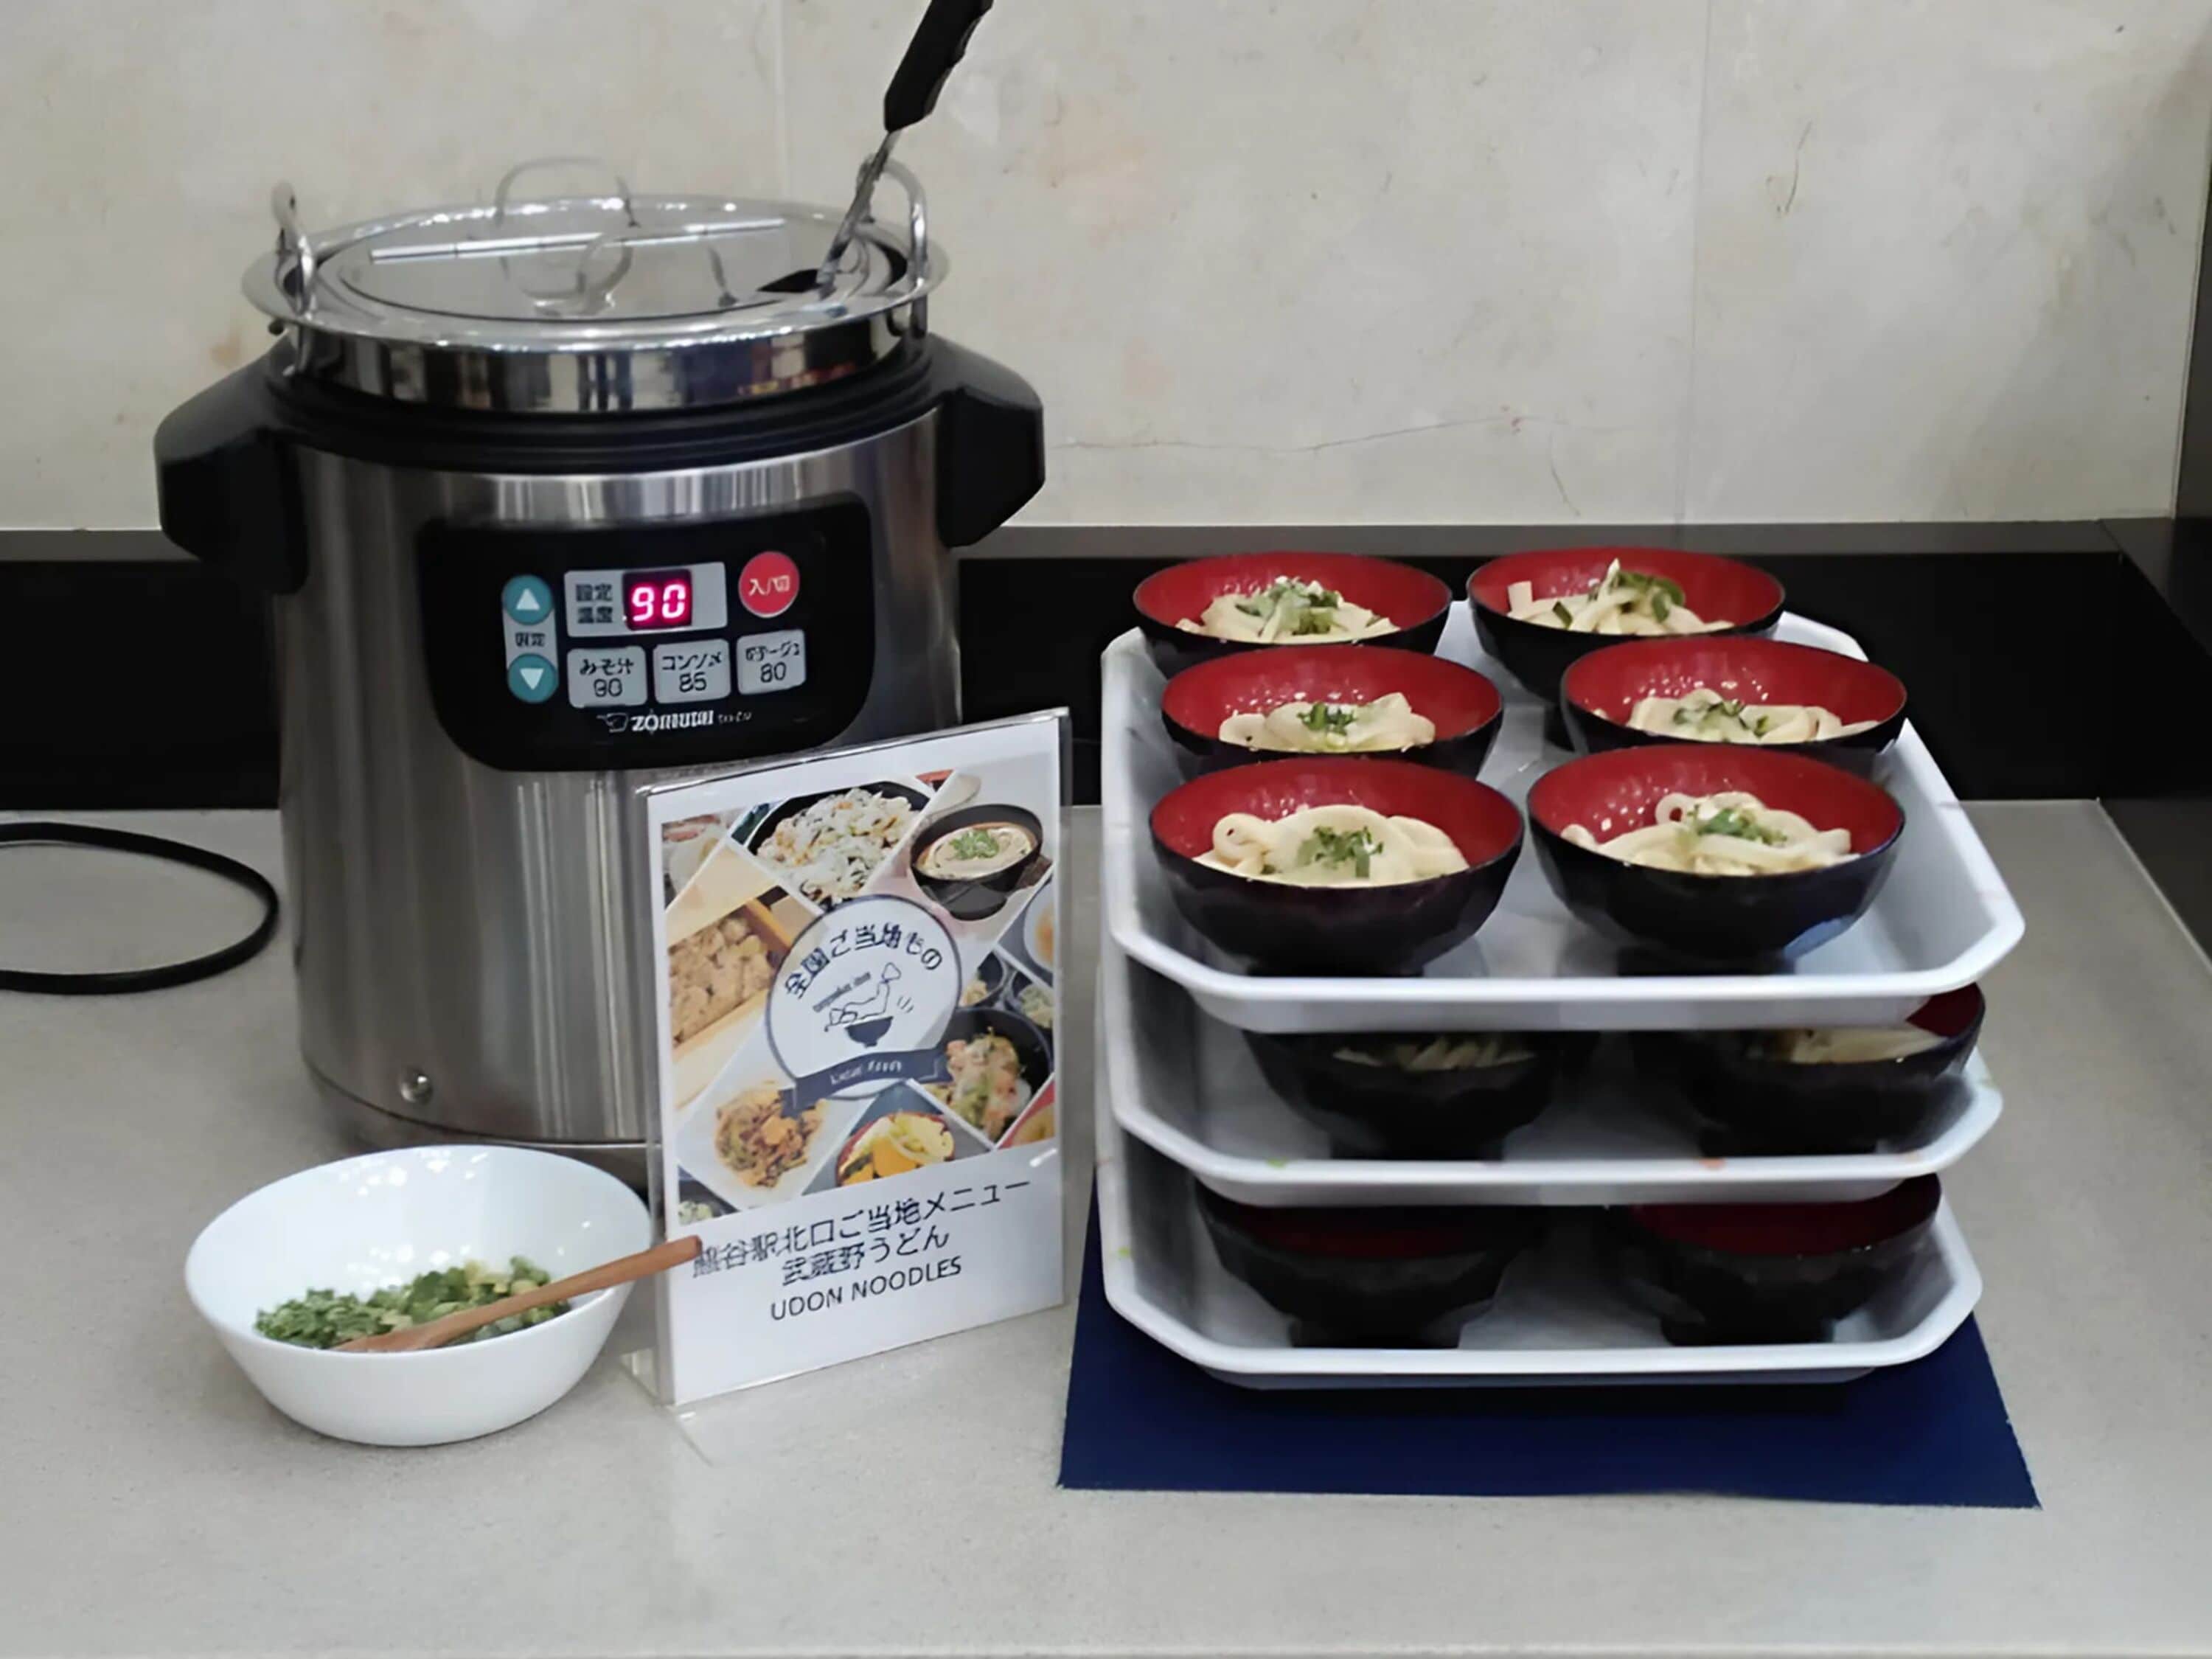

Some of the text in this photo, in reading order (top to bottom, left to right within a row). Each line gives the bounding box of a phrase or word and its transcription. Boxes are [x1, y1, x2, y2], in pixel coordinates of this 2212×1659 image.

[632, 584, 686, 621] 90
[580, 658, 634, 675] みそ汁
[661, 652, 722, 671] コンソメ
[760, 661, 787, 684] 80
[678, 672, 708, 693] 85
[785, 922, 943, 1000] 全国ご当地もの
[692, 1181, 1030, 1278] 熊谷駅北口ご当地メニュー
[782, 1225, 950, 1286] 武蔵野うどん
[771, 1255, 962, 1321] UDON NOODLES
